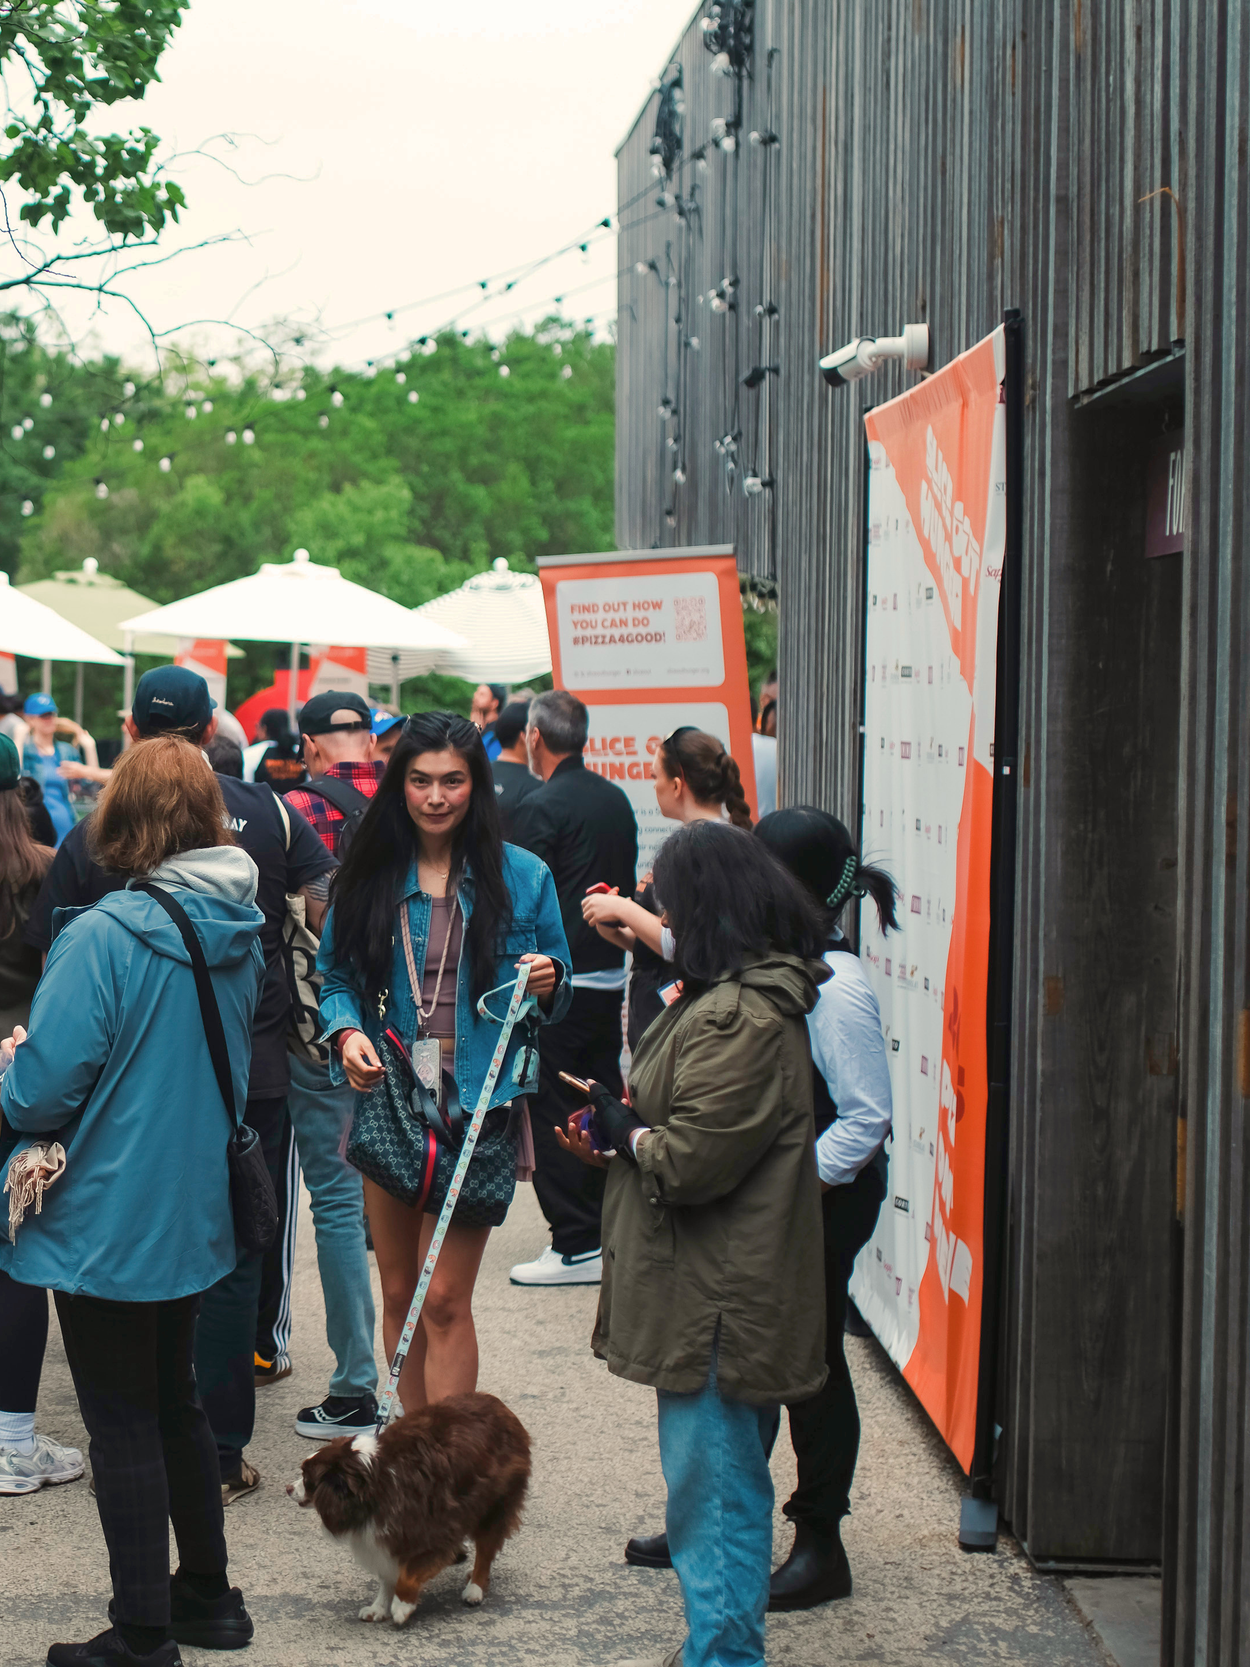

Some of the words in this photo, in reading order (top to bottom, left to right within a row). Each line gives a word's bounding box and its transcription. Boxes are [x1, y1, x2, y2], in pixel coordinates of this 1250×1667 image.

[953, 501, 980, 597] OUT
[570, 603, 600, 615] FIND
[603, 601, 629, 613] OUT
[632, 599, 663, 612] HOW
[572, 619, 598, 630] YOU
[601, 618, 628, 629] CAN
[632, 616, 650, 627] DO
[573, 631, 666, 645] #PIZZA4GOOD!
[585, 762, 655, 780] UNGE
